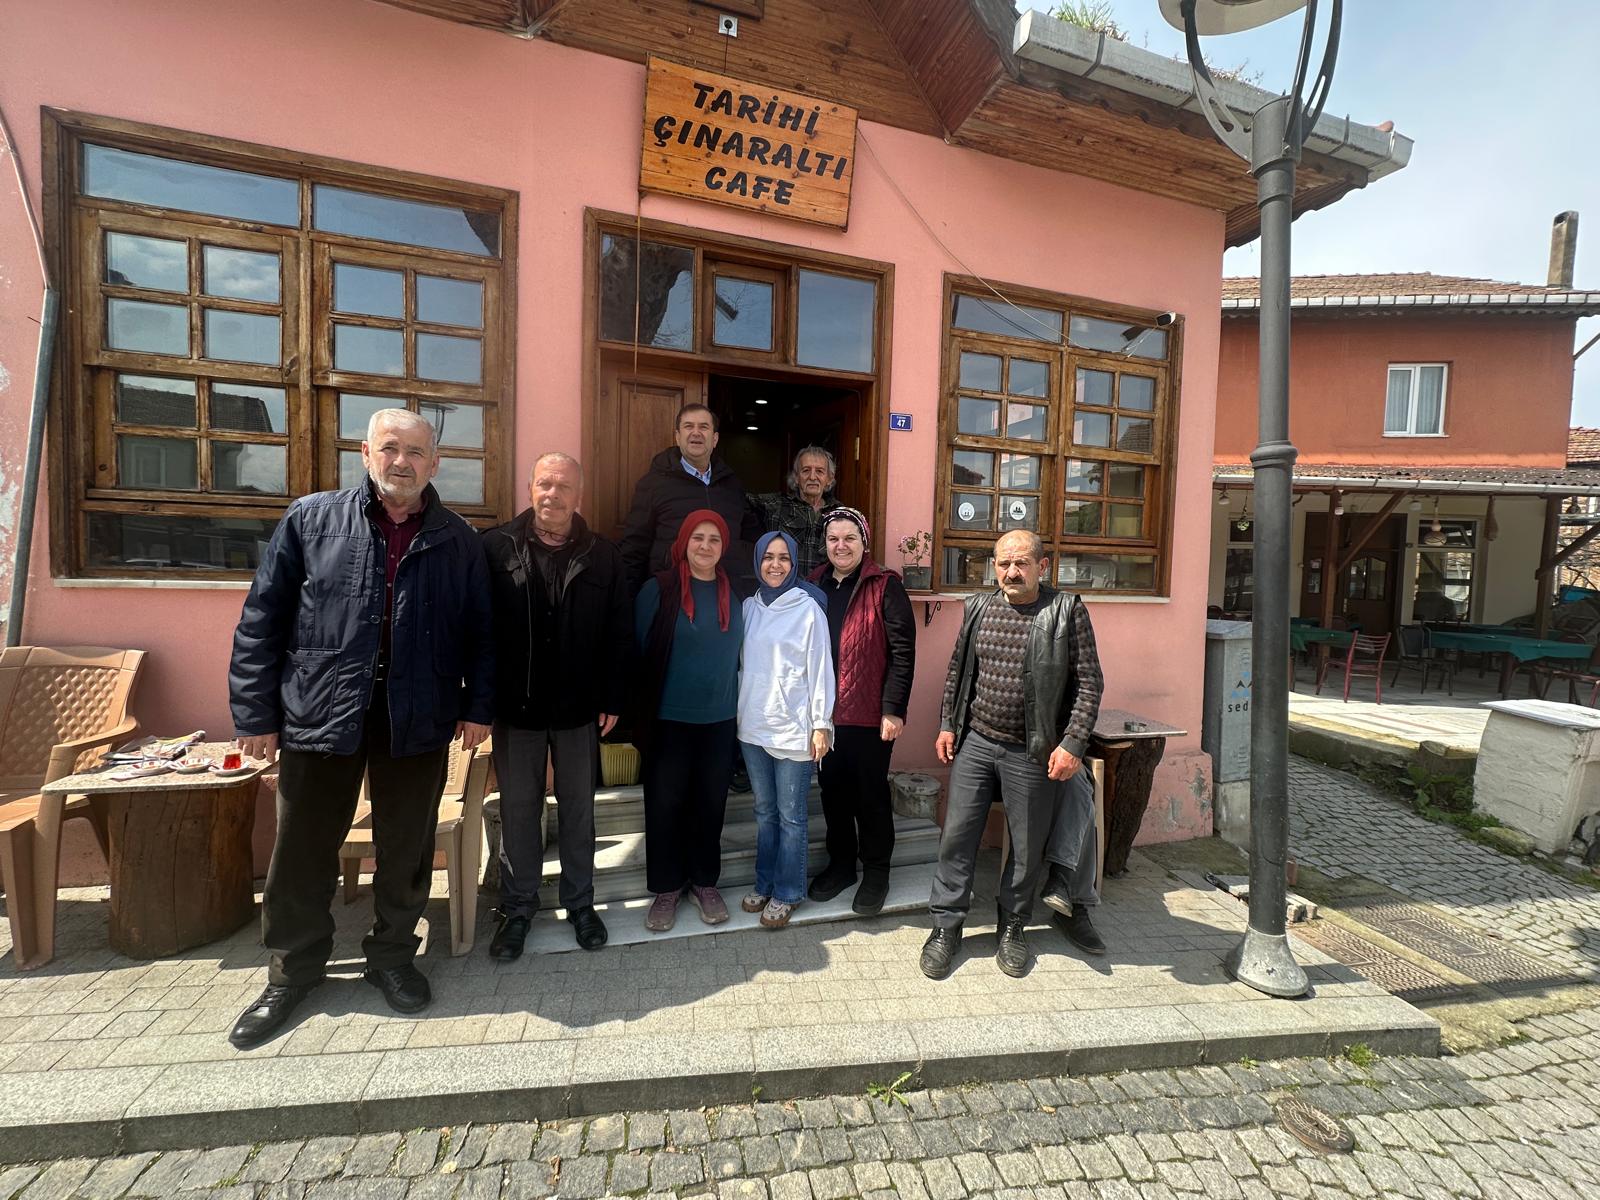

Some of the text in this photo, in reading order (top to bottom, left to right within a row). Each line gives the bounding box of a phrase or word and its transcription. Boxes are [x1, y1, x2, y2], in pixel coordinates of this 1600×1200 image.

[694, 83, 821, 135] TARİHİ
[653, 116, 847, 180] ÇINARALTI
[705, 167, 795, 205] CAFE
[897, 419, 906, 428] 47
[1227, 700, 1249, 713] sed
